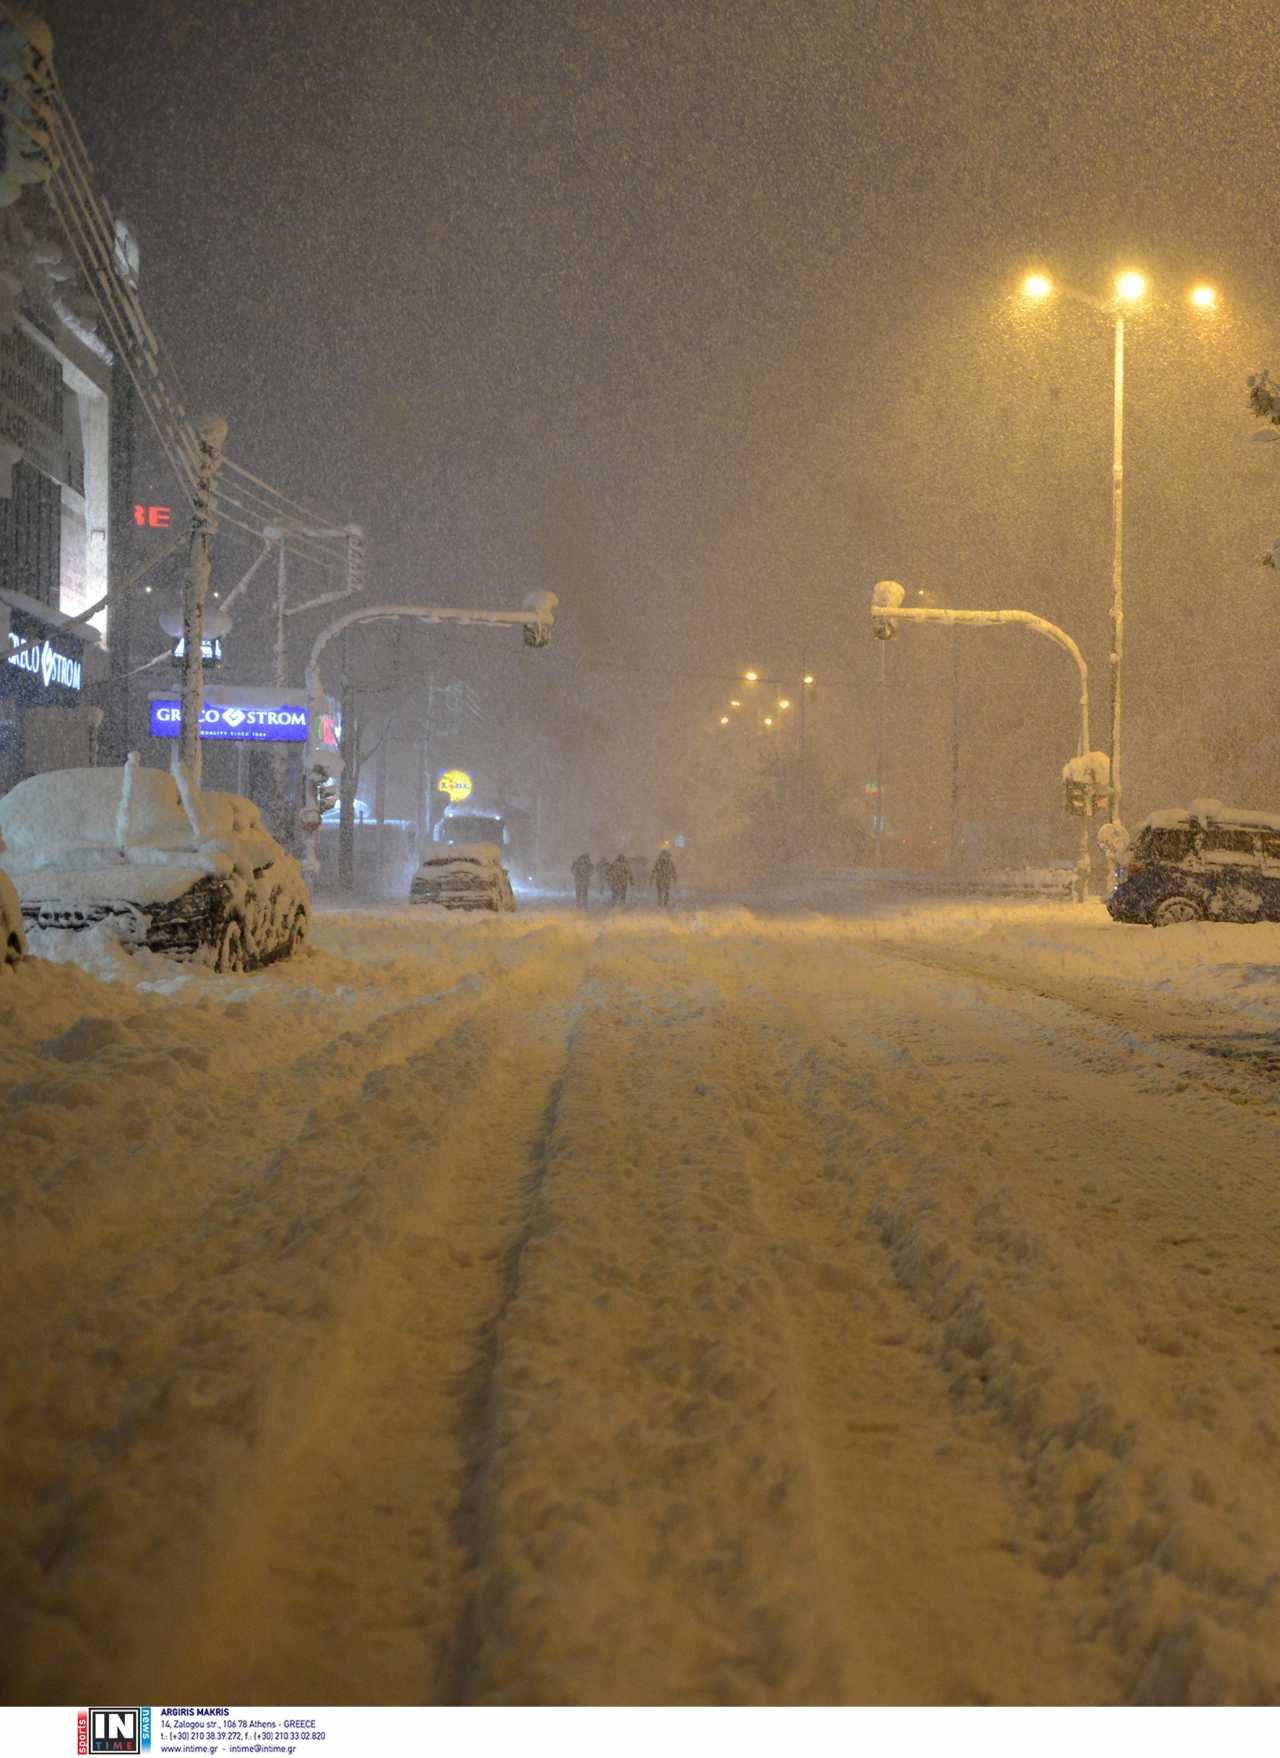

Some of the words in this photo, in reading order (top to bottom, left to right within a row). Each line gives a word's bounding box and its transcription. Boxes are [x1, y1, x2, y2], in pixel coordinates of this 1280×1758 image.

[52, 652, 81, 690] STROM
[156, 708, 219, 723] GRCO
[247, 711, 306, 725] STROM
